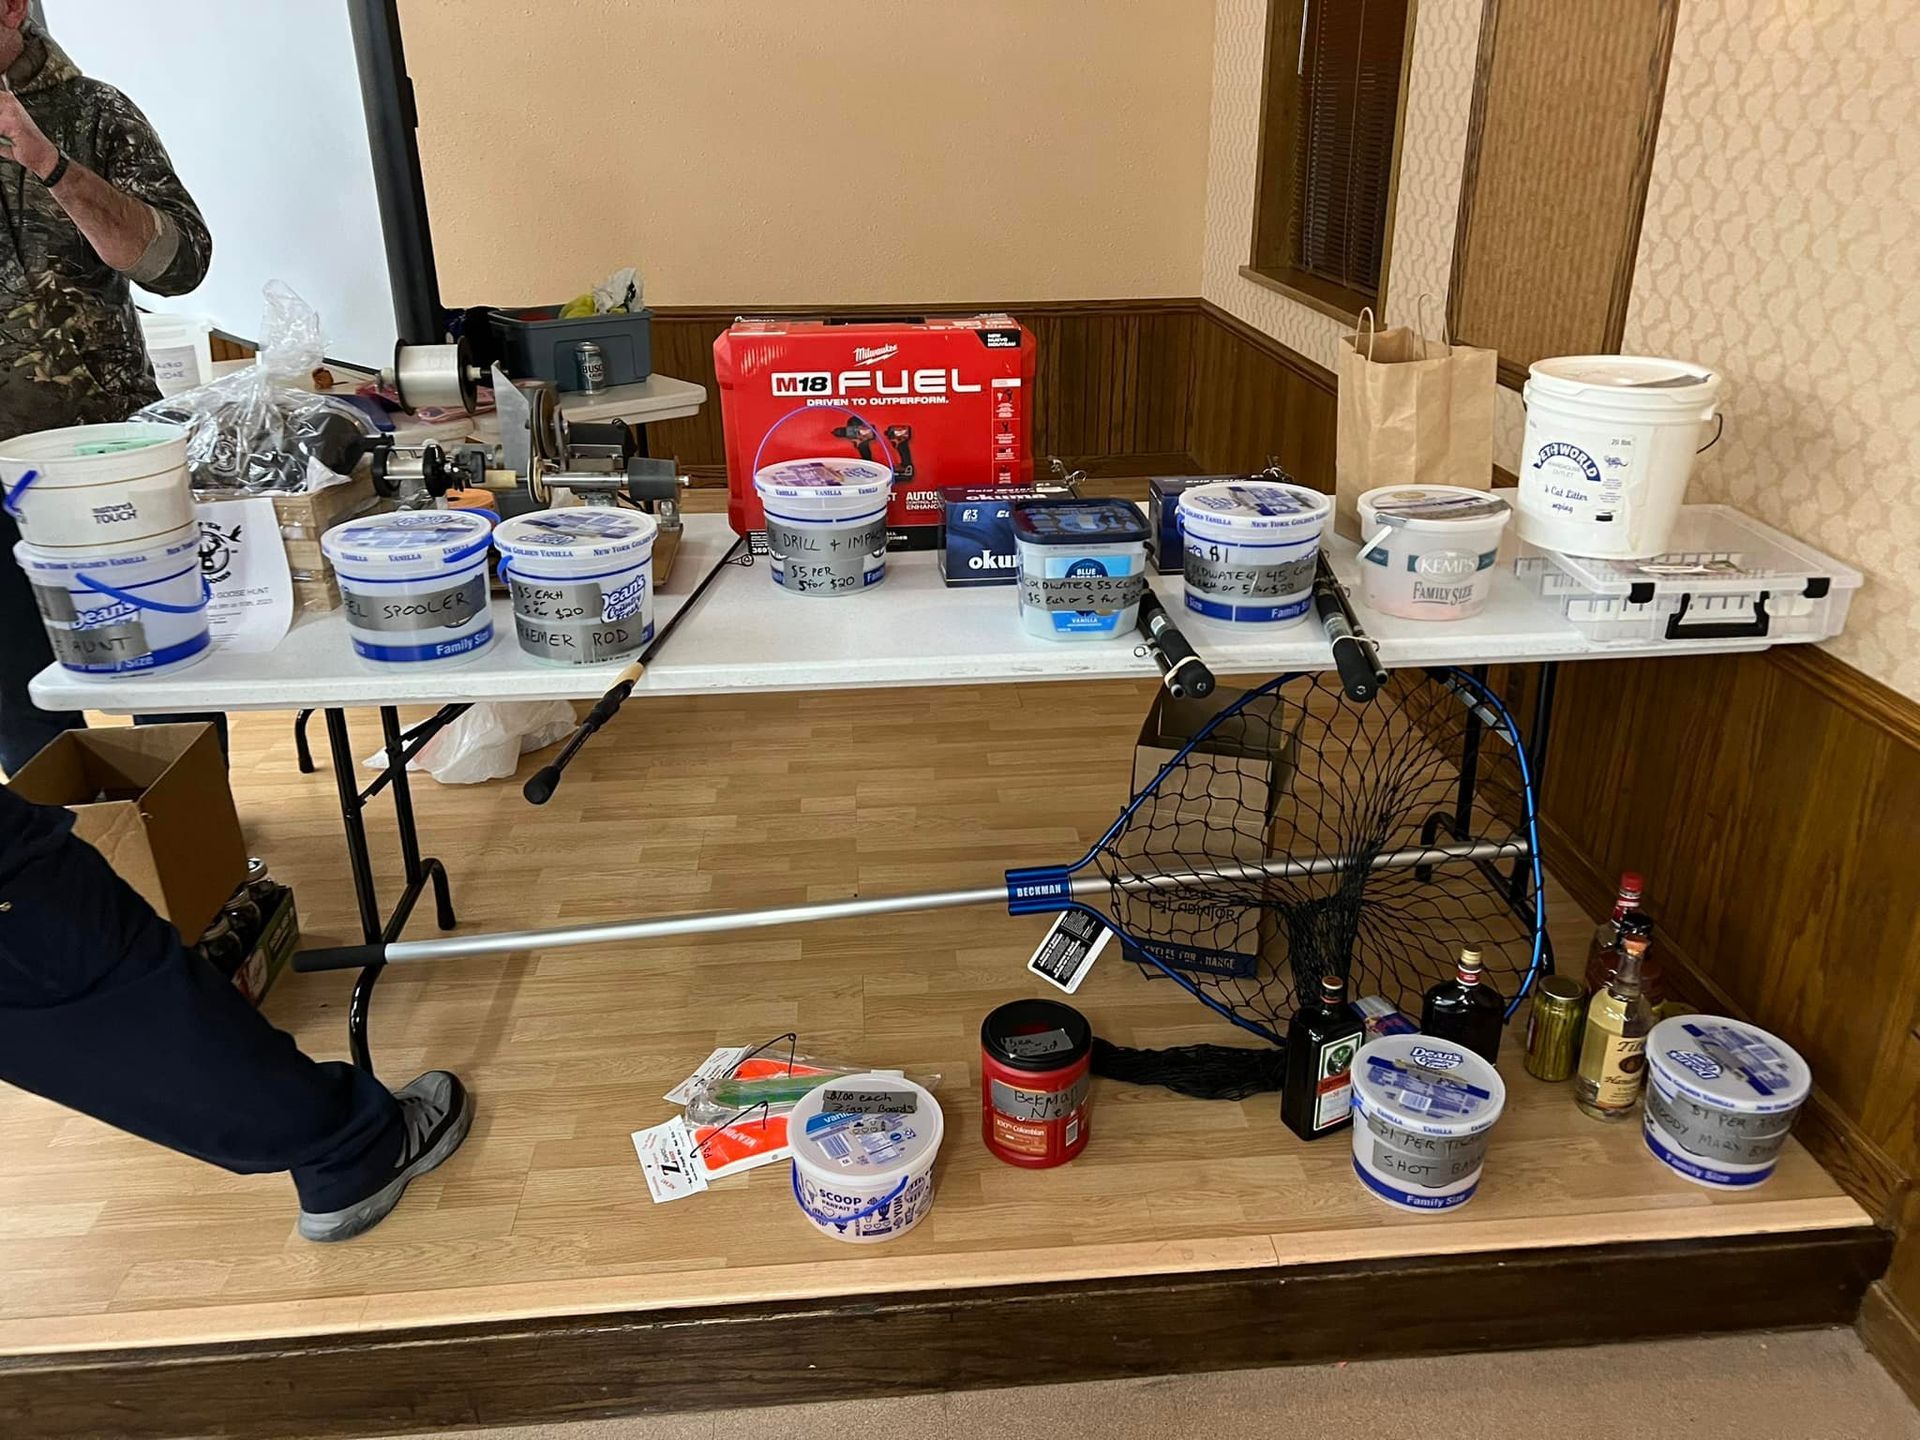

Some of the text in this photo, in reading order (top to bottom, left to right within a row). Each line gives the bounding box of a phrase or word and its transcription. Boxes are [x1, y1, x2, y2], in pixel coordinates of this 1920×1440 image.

[853, 343, 898, 361] Milwaukee
[775, 369, 982, 395] M18 FUEL
[806, 398, 849, 406] DRIVEN
[869, 396, 949, 405] OUTPERFORM.
[775, 488, 798, 497] VANILLA
[858, 486, 878, 496] VANILLA
[94, 510, 136, 523] TOUCH
[1205, 514, 1232, 526] VANILLA
[783, 534, 821, 552] DRILL
[541, 549, 574, 558] VANILLA
[593, 548, 611, 557] NEW
[612, 544, 631, 554] YORK
[109, 555, 147, 568] VANILLA
[388, 553, 422, 562] VANILLA
[791, 565, 836, 579] $5 PER
[1076, 568, 1097, 576] BLUE
[1266, 571, 1288, 583] 45
[829, 576, 855, 591] $20
[1271, 583, 1295, 594] $20
[217, 587, 269, 598] GOOSE HUNT
[1412, 581, 1450, 601] FAMILY
[384, 592, 470, 619] SPOOLER
[556, 607, 583, 619] $20
[1271, 608, 1300, 619] Family
[1072, 616, 1098, 624] VANILLA
[593, 630, 628, 646] ROD
[436, 640, 473, 656] Family
[1017, 884, 1061, 897] BECKMAN
[860, 1092, 892, 1102] each
[1377, 1108, 1403, 1125] VANILLA
[1719, 1113, 1746, 1129] PER
[1423, 1126, 1452, 1135] VANILLA
[1404, 1134, 1435, 1151] PER
[1384, 1155, 1438, 1175] SHOT
[1666, 1152, 1702, 1177] Family
[819, 1189, 862, 1206] SCOOP
[1406, 1194, 1465, 1208] Family Size
[822, 1199, 850, 1212] PARFAIT
[893, 1195, 903, 1218] YUM
